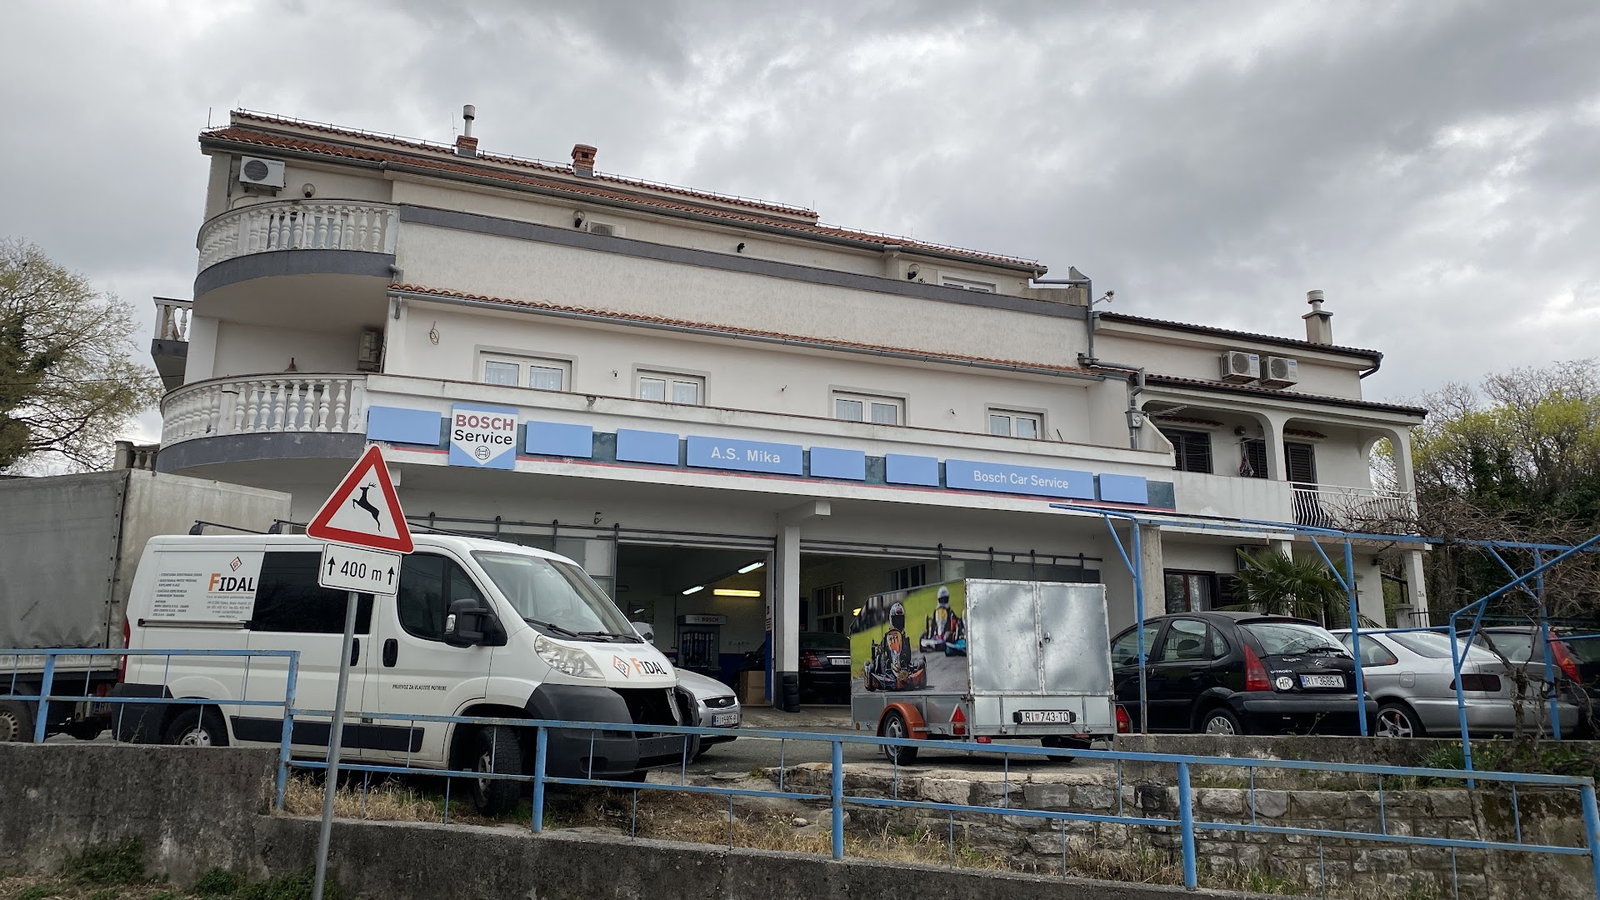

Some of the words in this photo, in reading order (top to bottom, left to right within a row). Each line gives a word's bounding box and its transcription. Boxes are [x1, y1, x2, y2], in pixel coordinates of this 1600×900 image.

[455, 414, 514, 431] BOSCH
[454, 429, 513, 445] Service
[711, 446, 740, 461] A.S.
[747, 449, 781, 463] Mika
[973, 470, 1006, 483] Bosch
[1009, 473, 1028, 485] Car
[1030, 474, 1069, 489] Service
[340, 561, 366, 579] 400
[371, 569, 382, 581] m
[208, 573, 255, 592] FIDAL
[629, 657, 668, 675] FIDAL
[1279, 677, 1291, 687] HR
[1306, 676, 1314, 687] RI
[1025, 712, 1034, 721] RI
[1040, 712, 1069, 721] 743-TO
